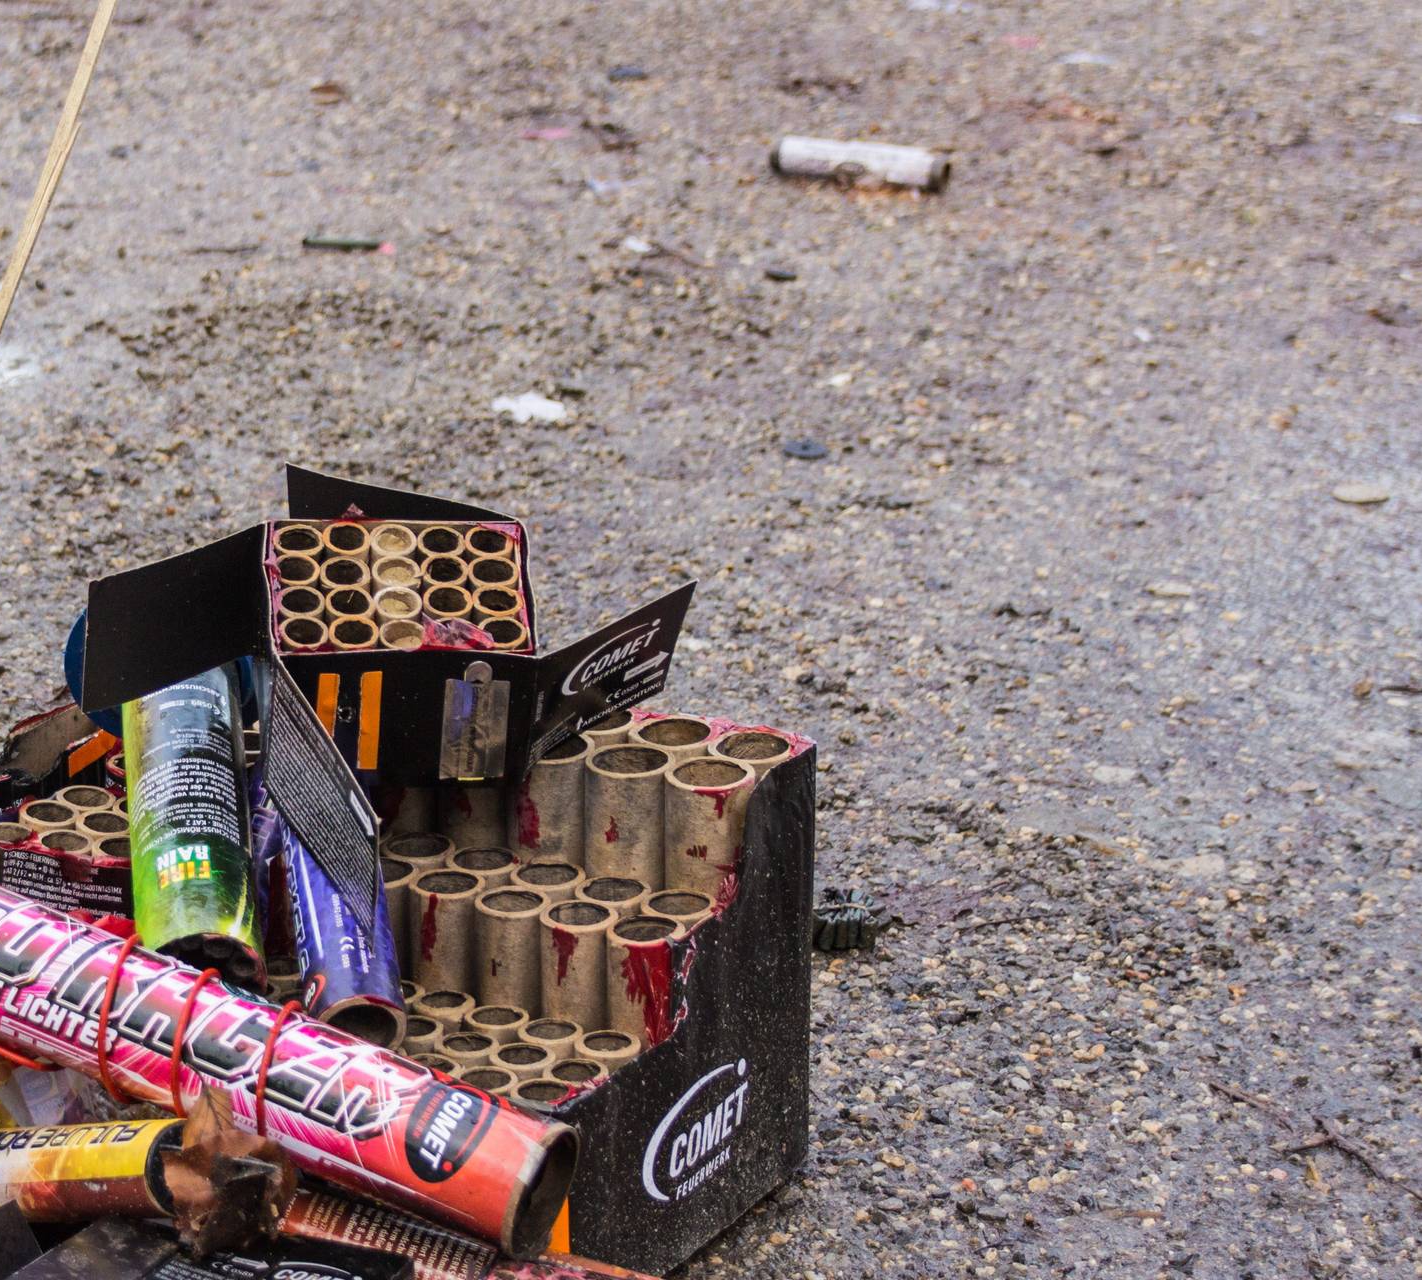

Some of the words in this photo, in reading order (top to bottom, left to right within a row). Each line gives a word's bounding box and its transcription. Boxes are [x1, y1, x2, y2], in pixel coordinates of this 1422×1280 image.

[581, 628, 660, 683] COMET
[583, 656, 635, 690] FEUERWERK
[157, 845, 209, 870] RAIN
[159, 861, 210, 889] FIRE
[5, 987, 119, 1055] LICHTER
[53, 935, 434, 1140] RACER
[419, 1094, 472, 1169] COMET
[670, 1081, 748, 1178] COMET
[676, 1145, 731, 1200] FEUERWERK
